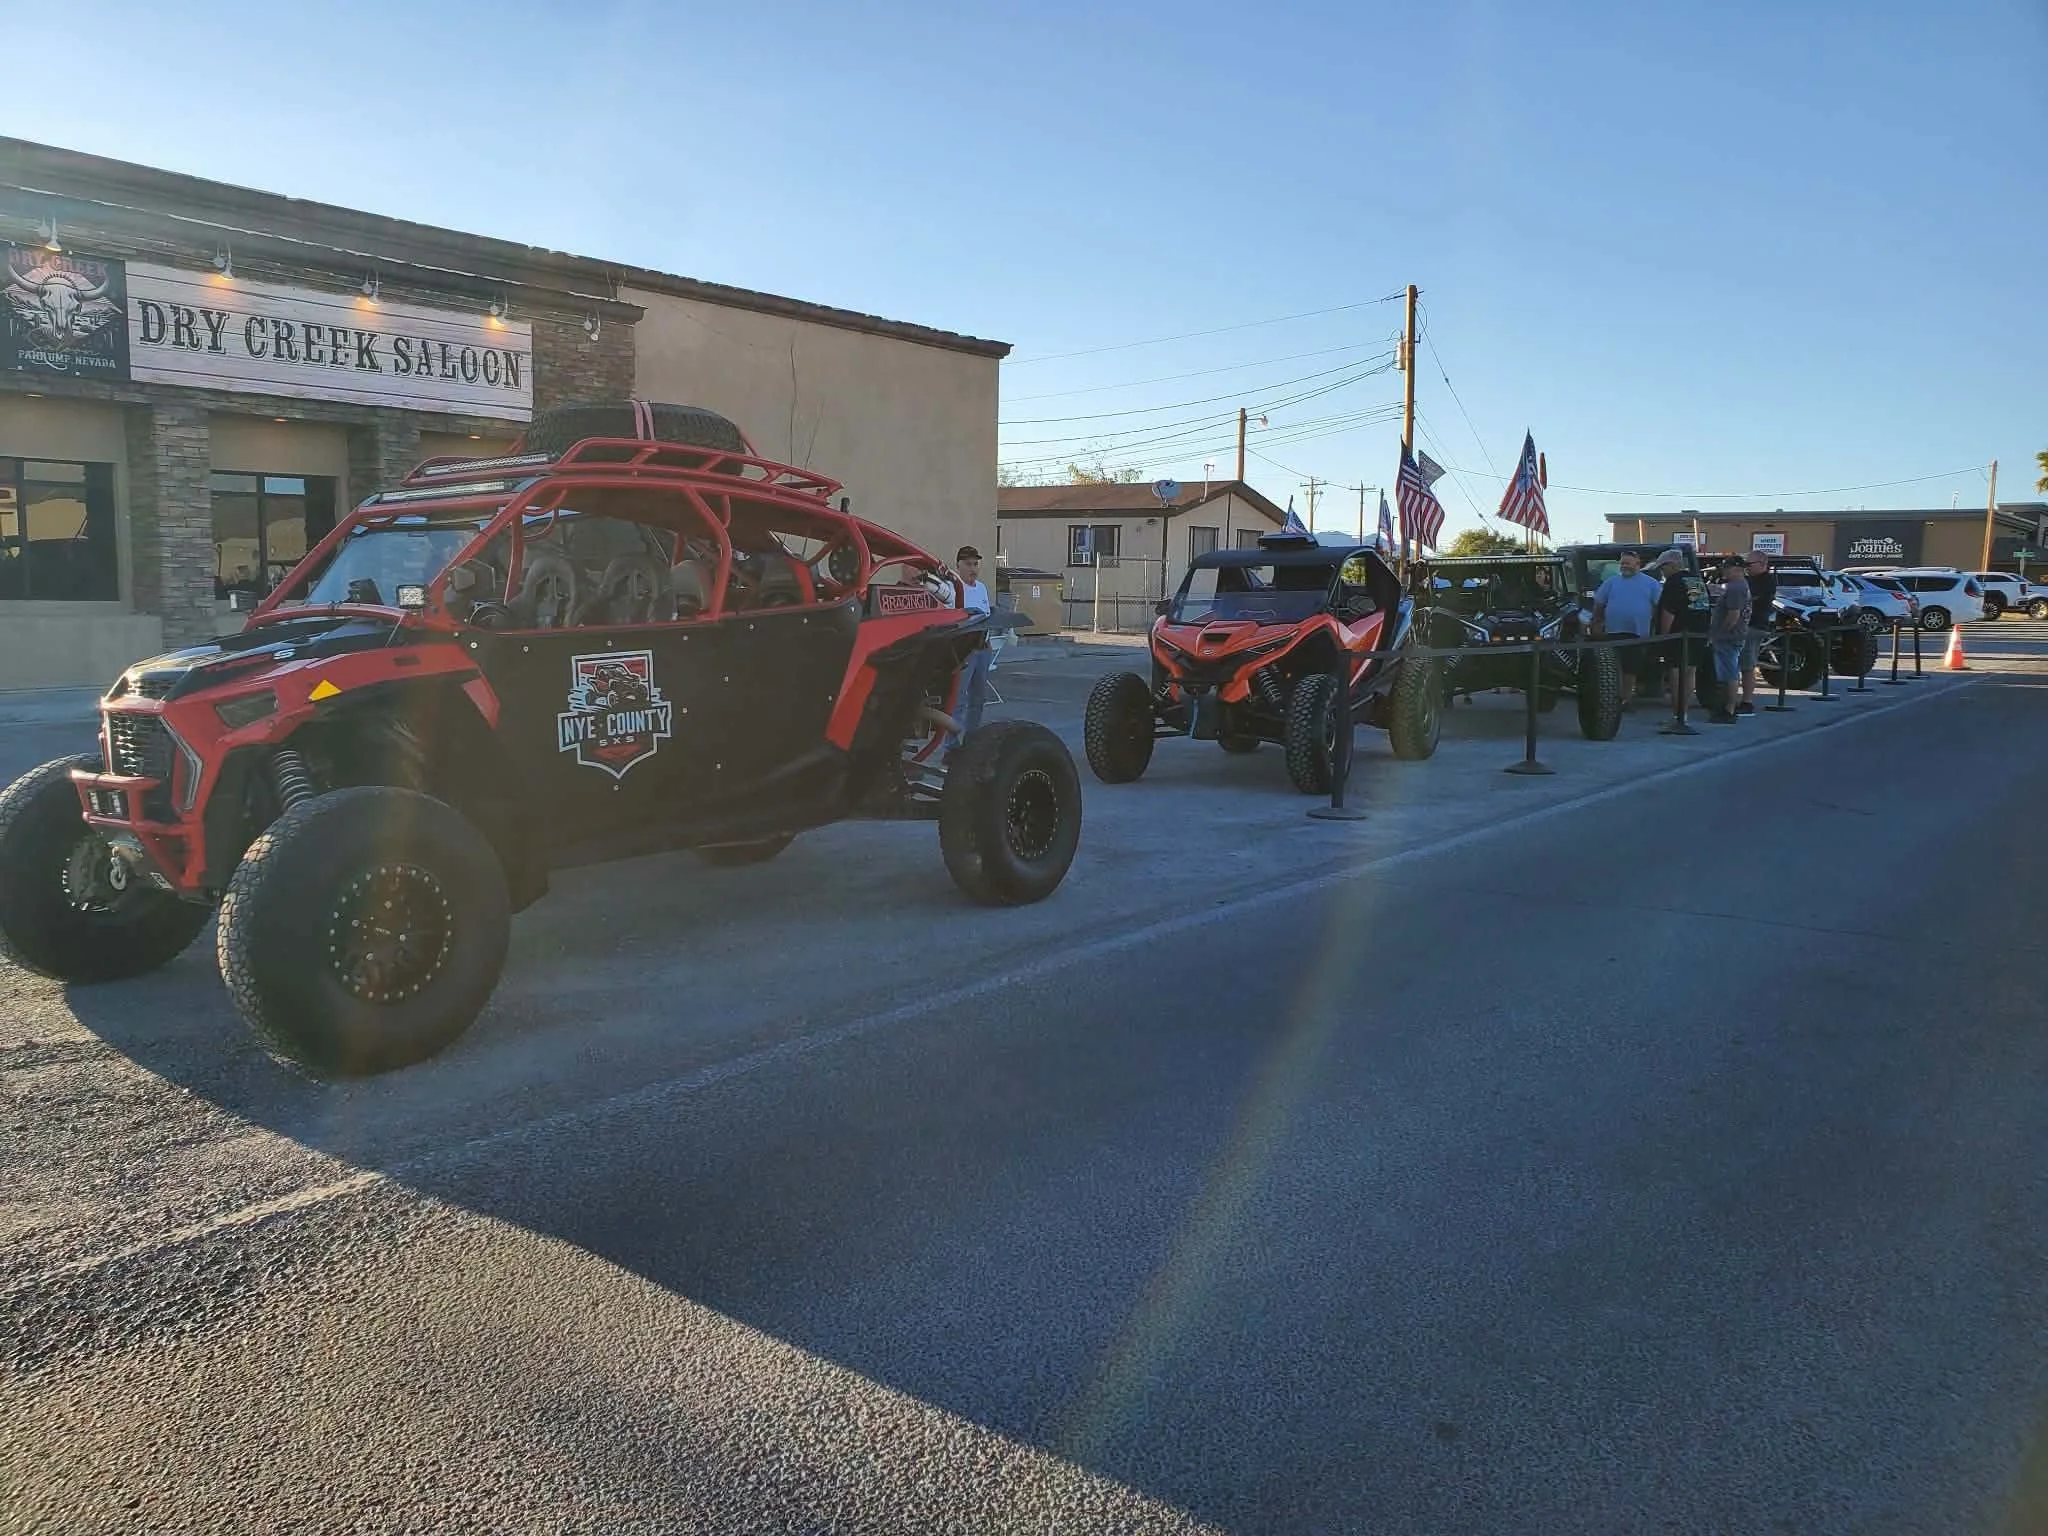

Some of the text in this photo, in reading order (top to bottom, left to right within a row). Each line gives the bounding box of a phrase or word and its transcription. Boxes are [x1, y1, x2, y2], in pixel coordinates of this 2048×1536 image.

[9, 247, 107, 278] DRY CREEK
[137, 300, 230, 354] DRY
[245, 316, 382, 373] CREEK
[393, 336, 522, 389] SALOON
[17, 349, 117, 369] PAHRUMP NEVADA
[1850, 541, 1903, 553] Joanie's
[564, 706, 667, 744] NYE COUNTY
[599, 735, 635, 747] SXS
